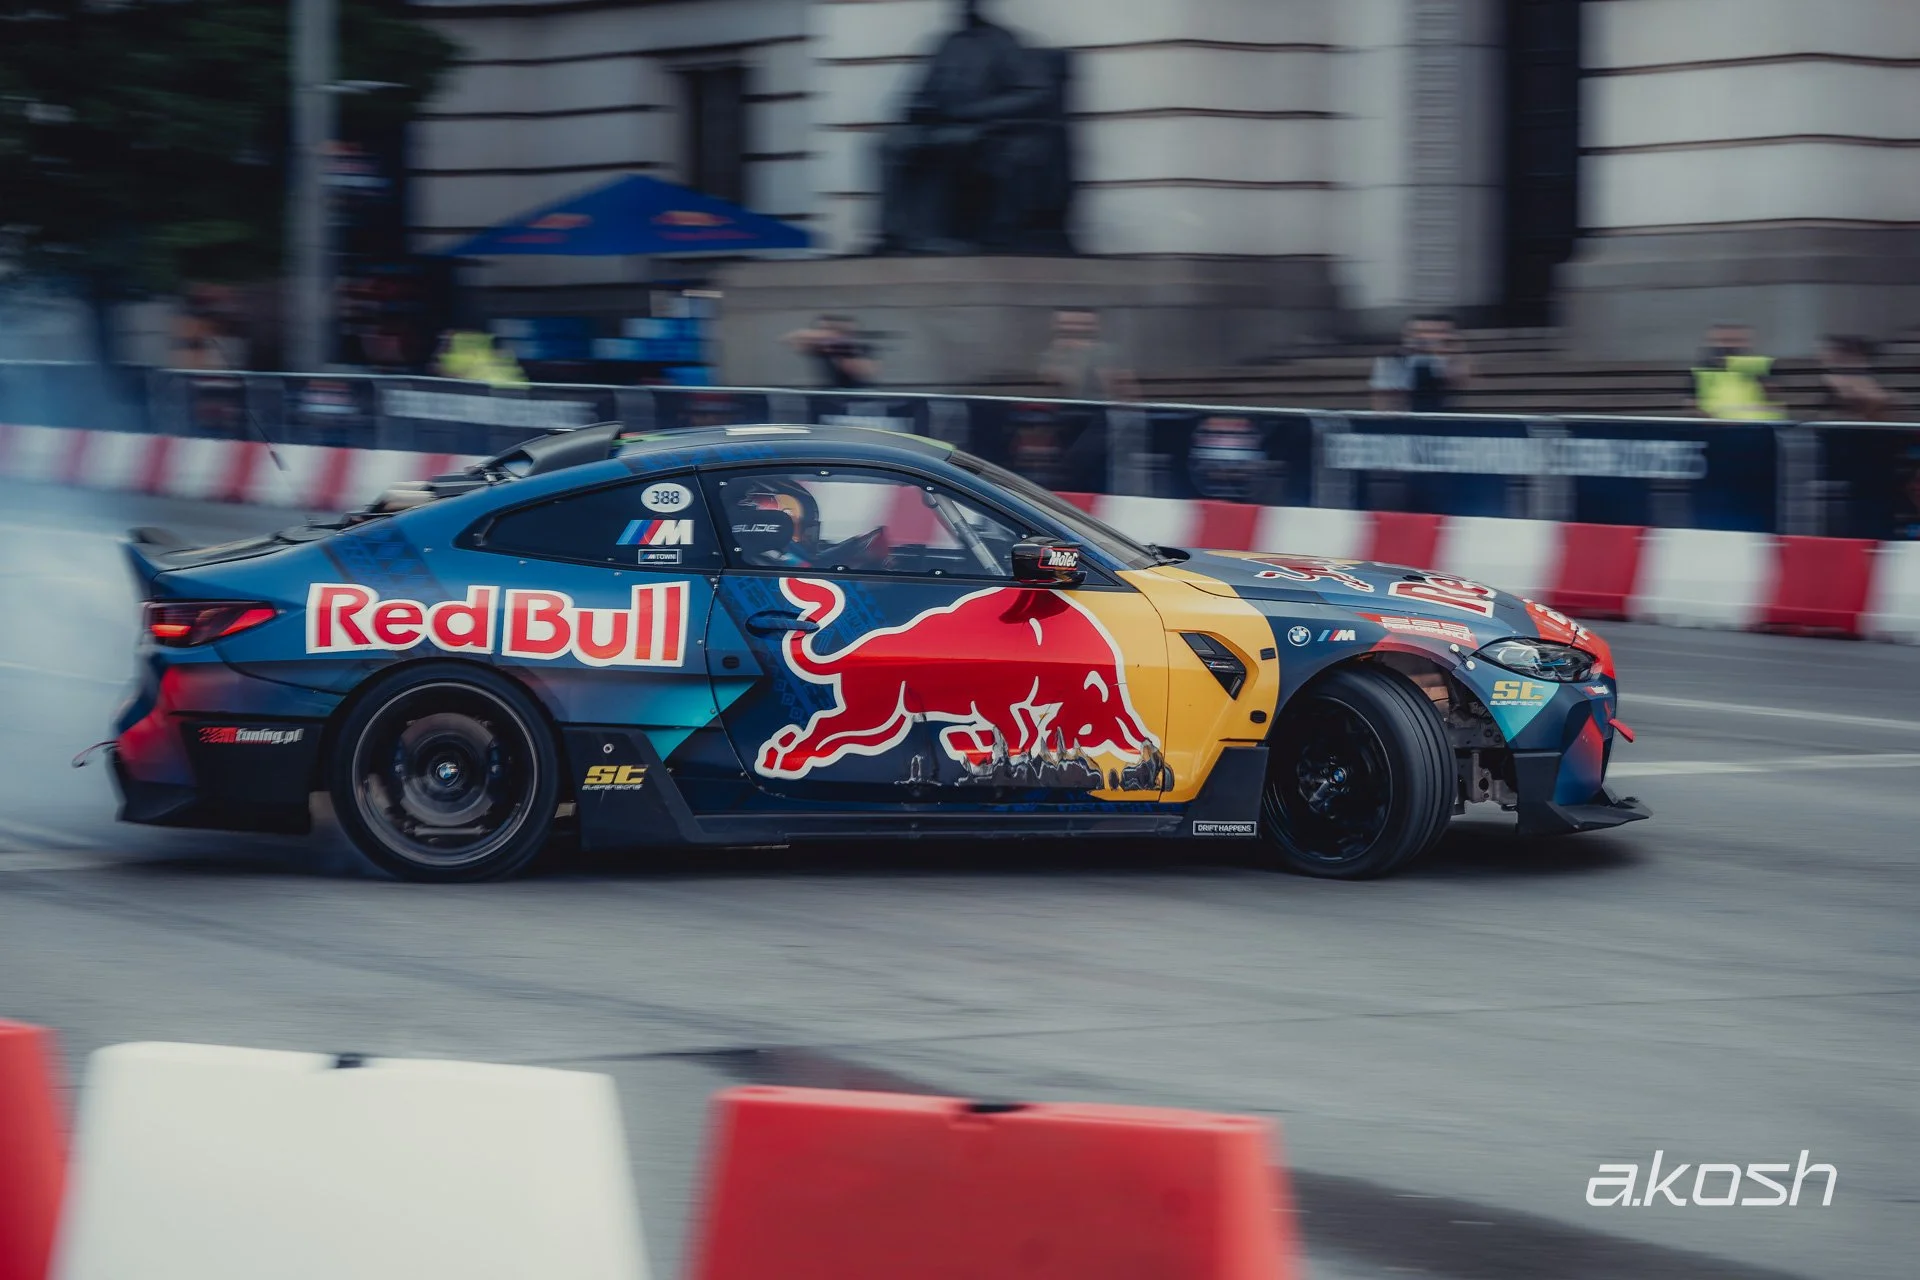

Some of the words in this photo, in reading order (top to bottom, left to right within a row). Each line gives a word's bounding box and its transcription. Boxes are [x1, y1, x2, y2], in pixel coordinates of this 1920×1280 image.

[651, 490, 680, 505] 388
[731, 523, 781, 533] SLIDE
[1047, 551, 1079, 567] MoTeC
[305, 582, 501, 654] Red
[501, 580, 691, 667] Bull
[1197, 824, 1218, 832] DRIFT
[1218, 824, 1252, 832] HAPPENS
